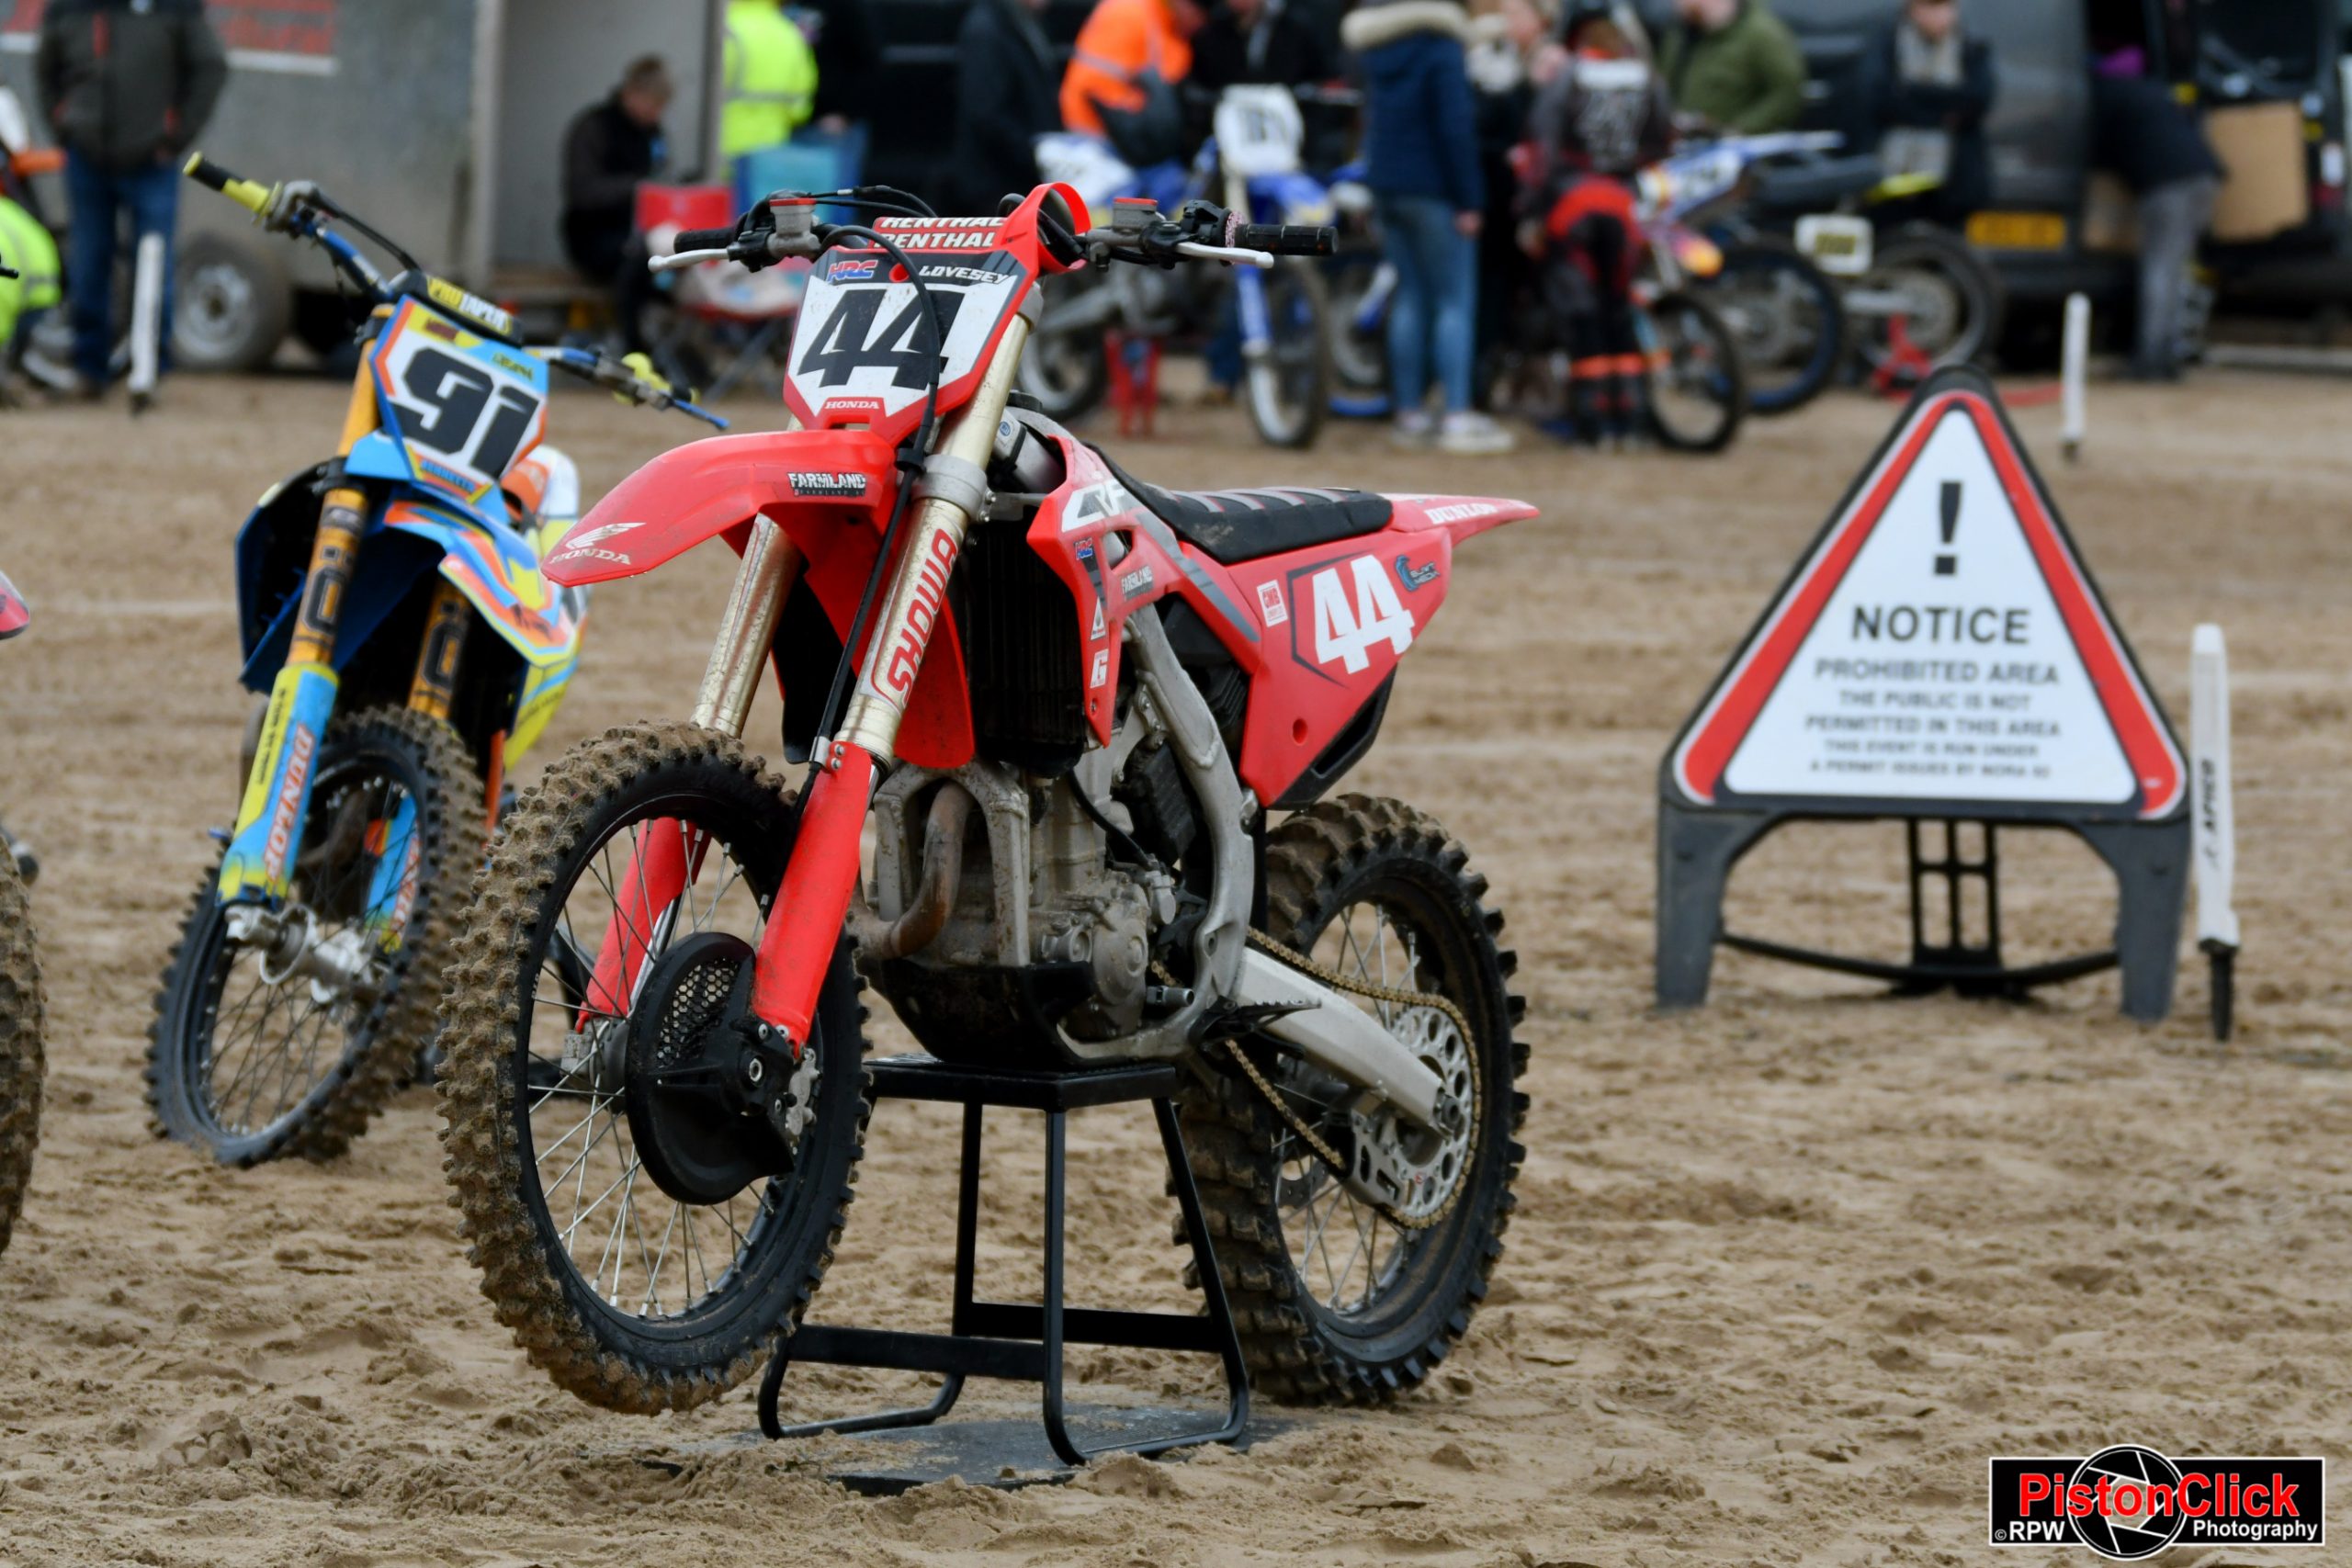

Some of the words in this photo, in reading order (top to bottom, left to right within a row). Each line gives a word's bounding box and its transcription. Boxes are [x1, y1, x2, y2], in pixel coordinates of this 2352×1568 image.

[828, 260, 879, 283] HRC
[919, 265, 1010, 284] LOVESEY
[797, 288, 967, 391] 44
[389, 346, 541, 481] 91
[825, 400, 880, 410] HONDA
[787, 472, 866, 489] FARMLAND
[549, 548, 631, 565] HONDA
[887, 528, 958, 707] SHOWA
[1312, 554, 1416, 675] 44
[1852, 605, 2030, 644] NOTICE
[1815, 657, 1979, 682] PROHIBITED
[1987, 662, 2059, 684] AREA
[1839, 690, 1875, 707] THE
[1884, 691, 1957, 709] PUBLIC
[1989, 694, 2032, 711] NOT
[1805, 714, 1920, 734] PERMITTED
[1955, 716, 2000, 736] THIS
[2007, 719, 2062, 738] AREA
